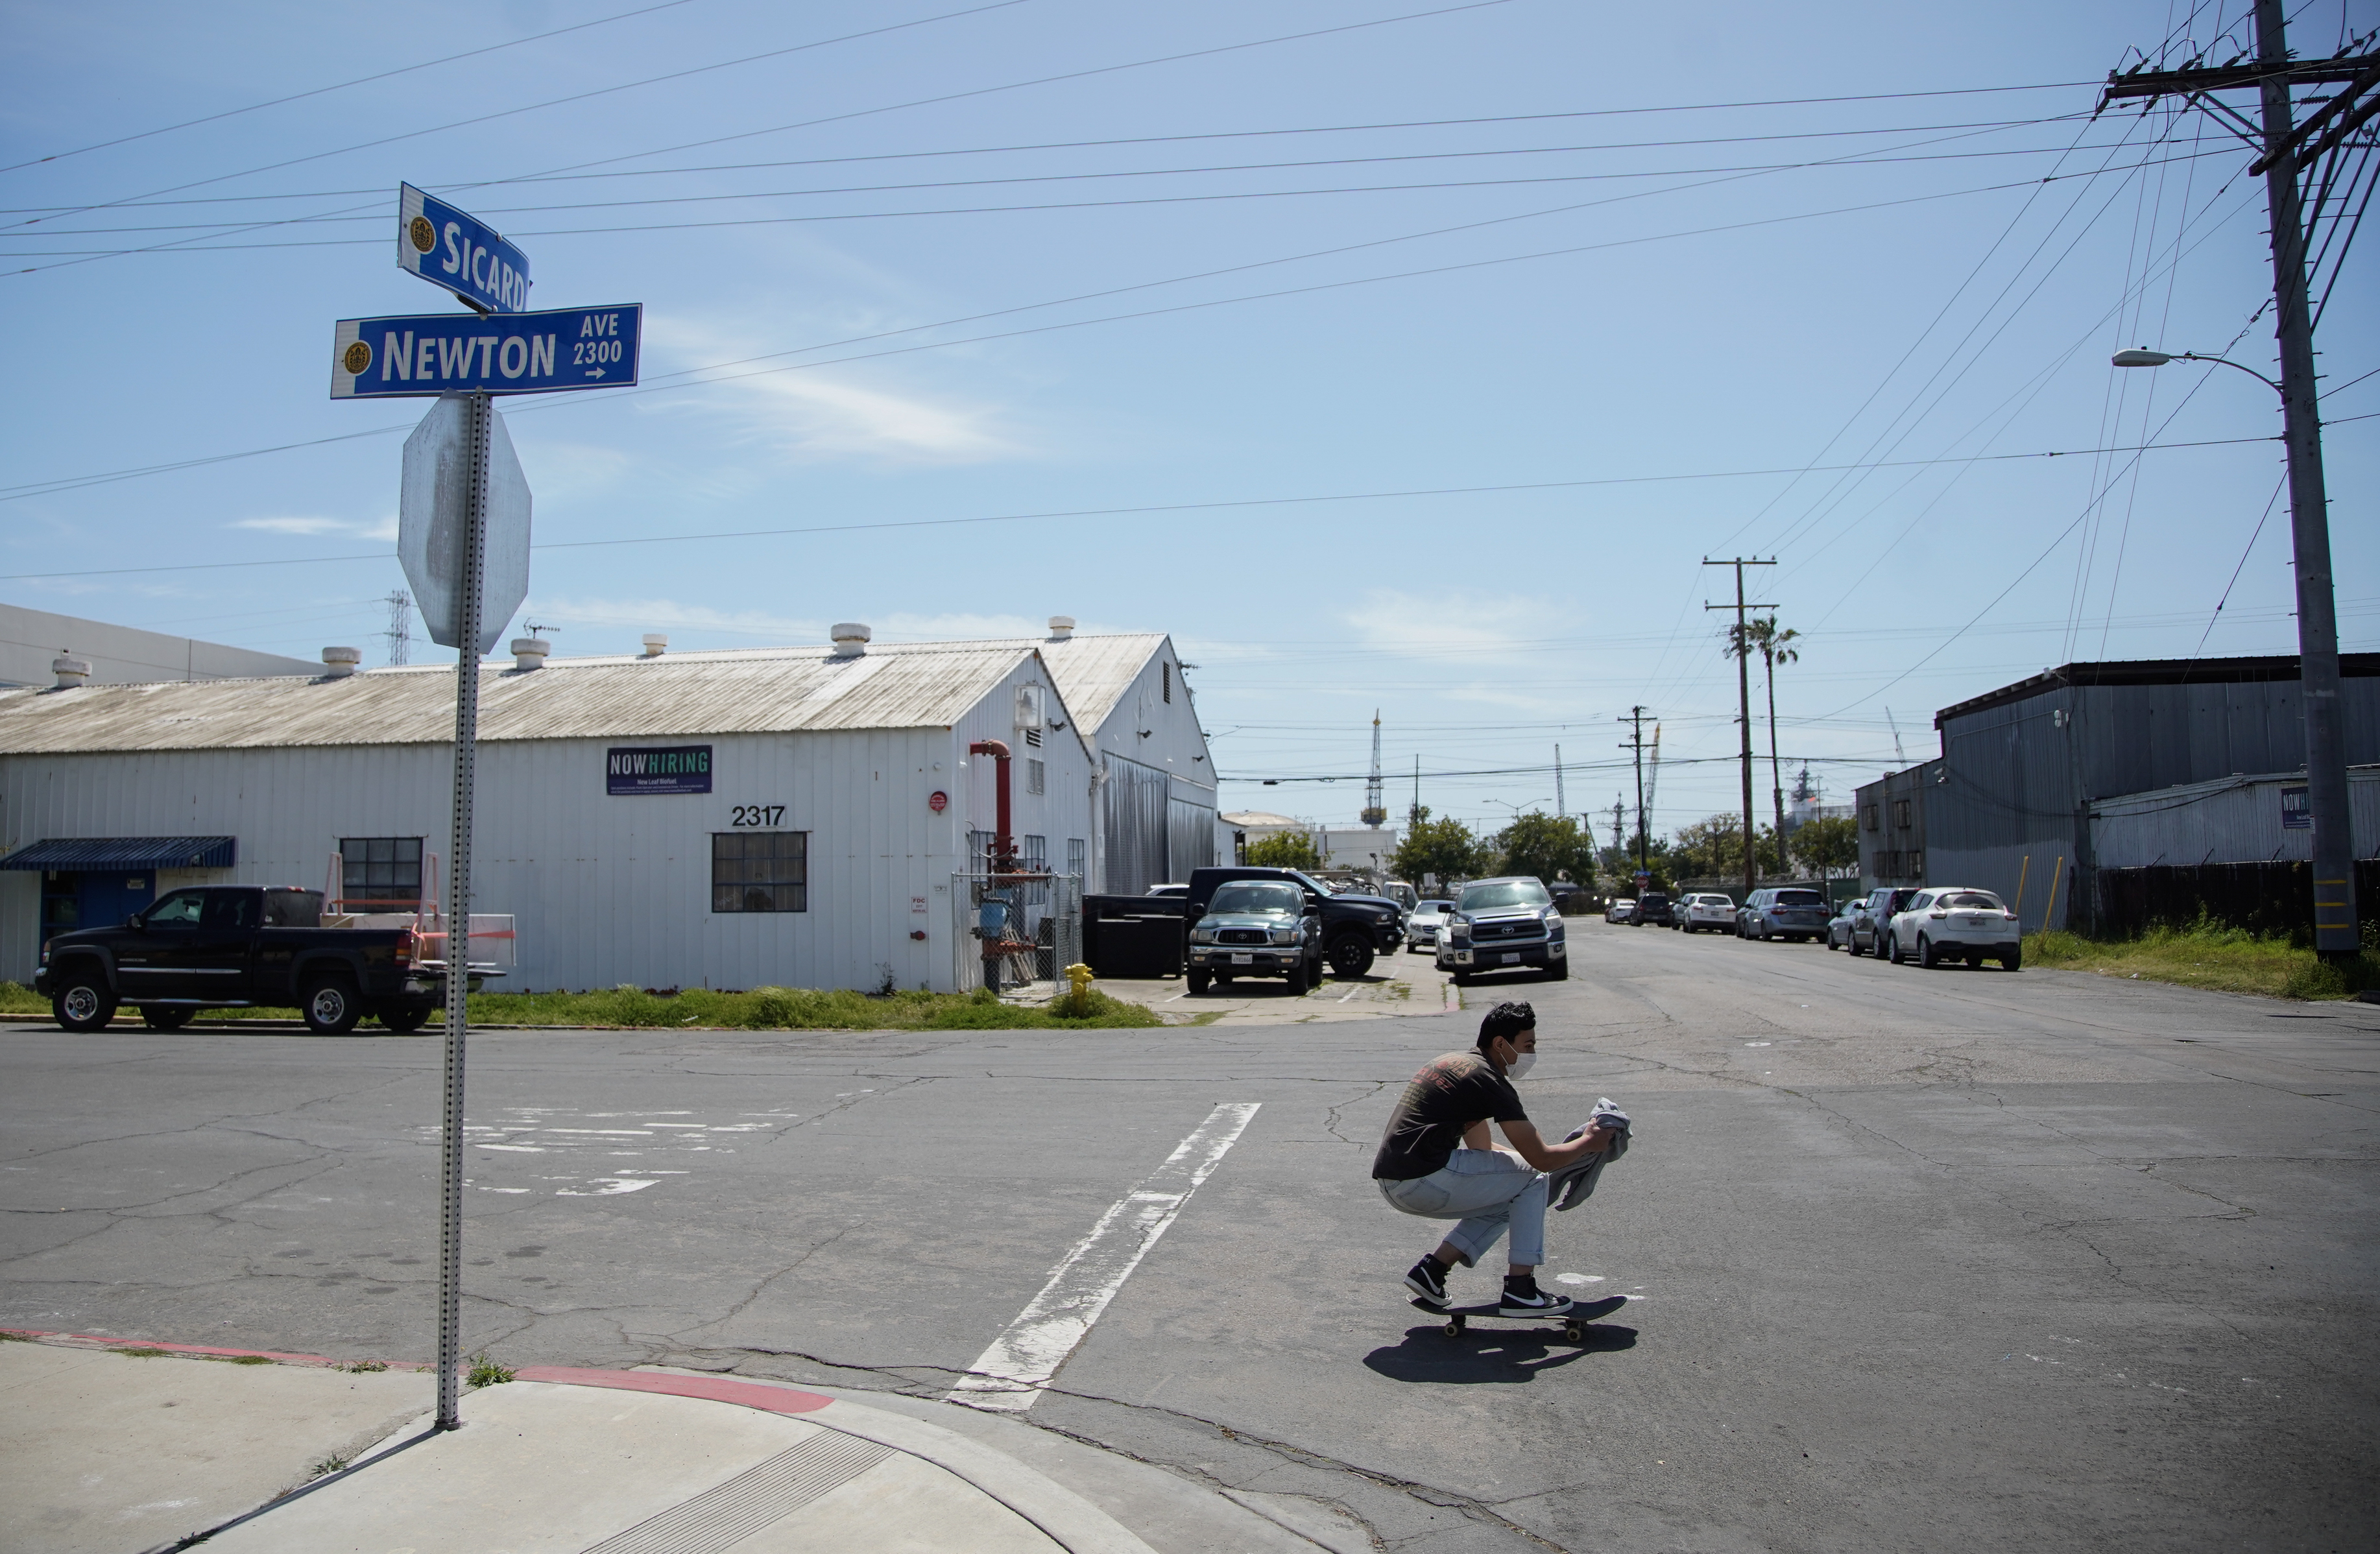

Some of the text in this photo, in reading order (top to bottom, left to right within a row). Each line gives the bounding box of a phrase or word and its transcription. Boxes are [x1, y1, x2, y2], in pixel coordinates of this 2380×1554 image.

[442, 221, 525, 312] SICARD
[581, 314, 618, 337] AVE
[382, 331, 556, 381] NEWTON
[573, 341, 622, 365] 2300
[732, 806, 785, 826] 2317
